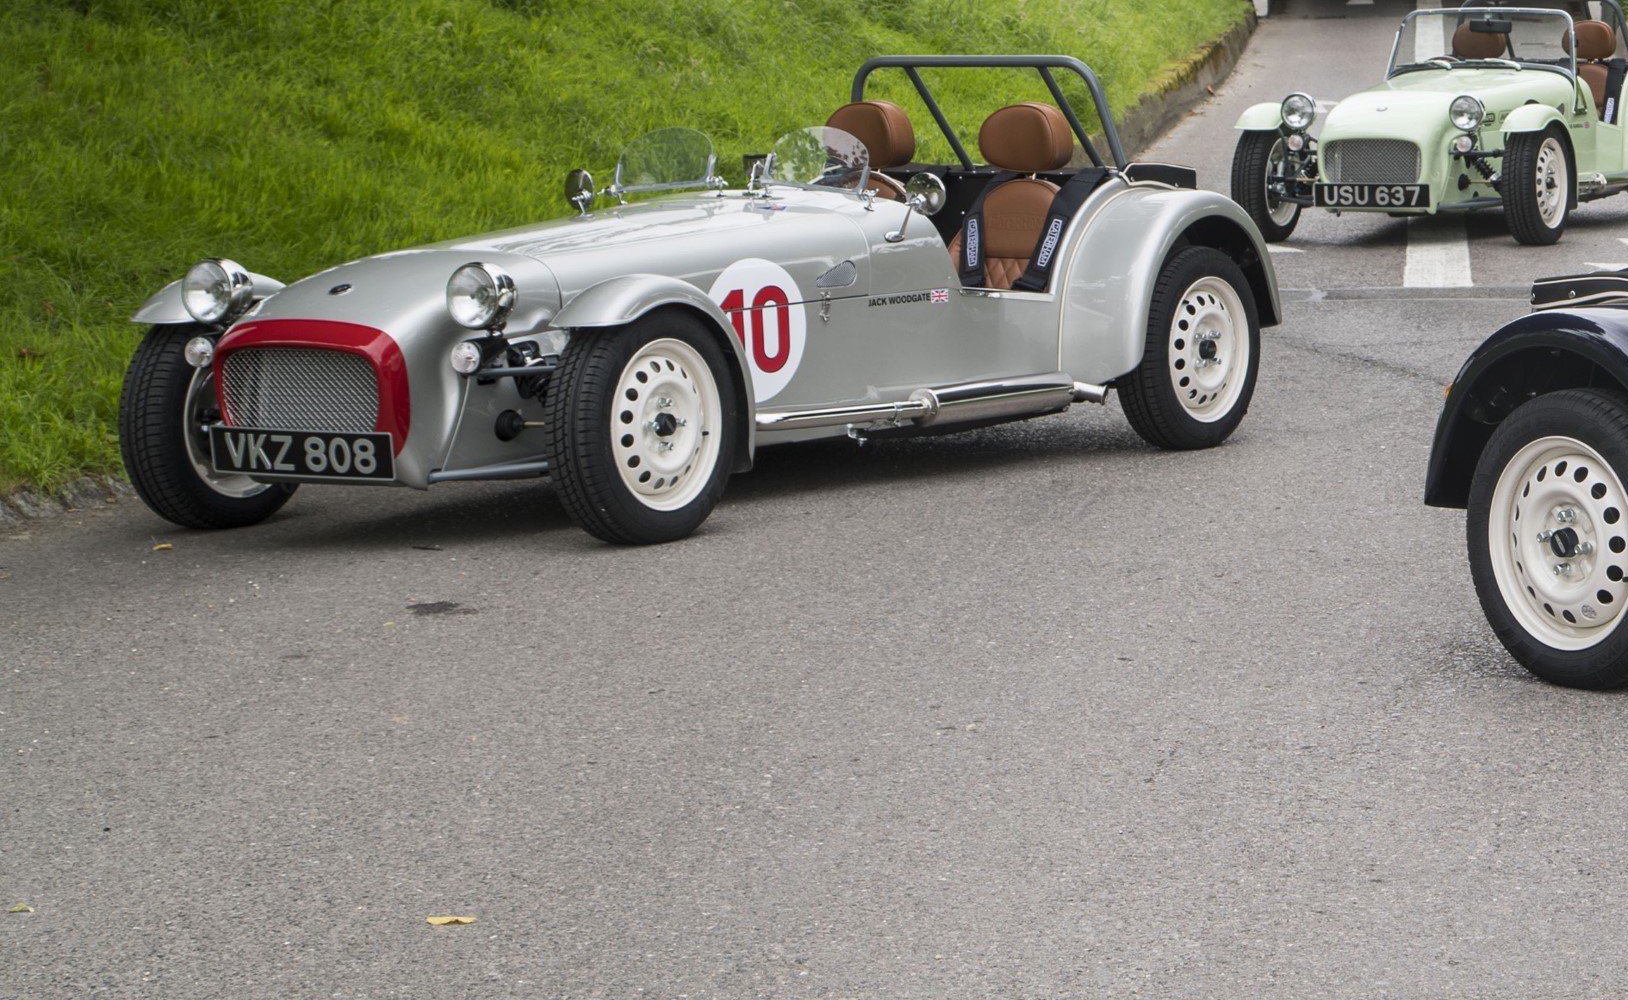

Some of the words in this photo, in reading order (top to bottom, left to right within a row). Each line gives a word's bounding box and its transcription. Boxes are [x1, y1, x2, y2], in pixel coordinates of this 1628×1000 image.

[1323, 185, 1369, 206] USU
[1375, 185, 1420, 206] 637
[868, 298, 888, 308] JACK
[888, 293, 931, 305] WOODGATE
[720, 285, 791, 373] 10
[224, 432, 296, 472] VKZ
[304, 436, 377, 475] 808
